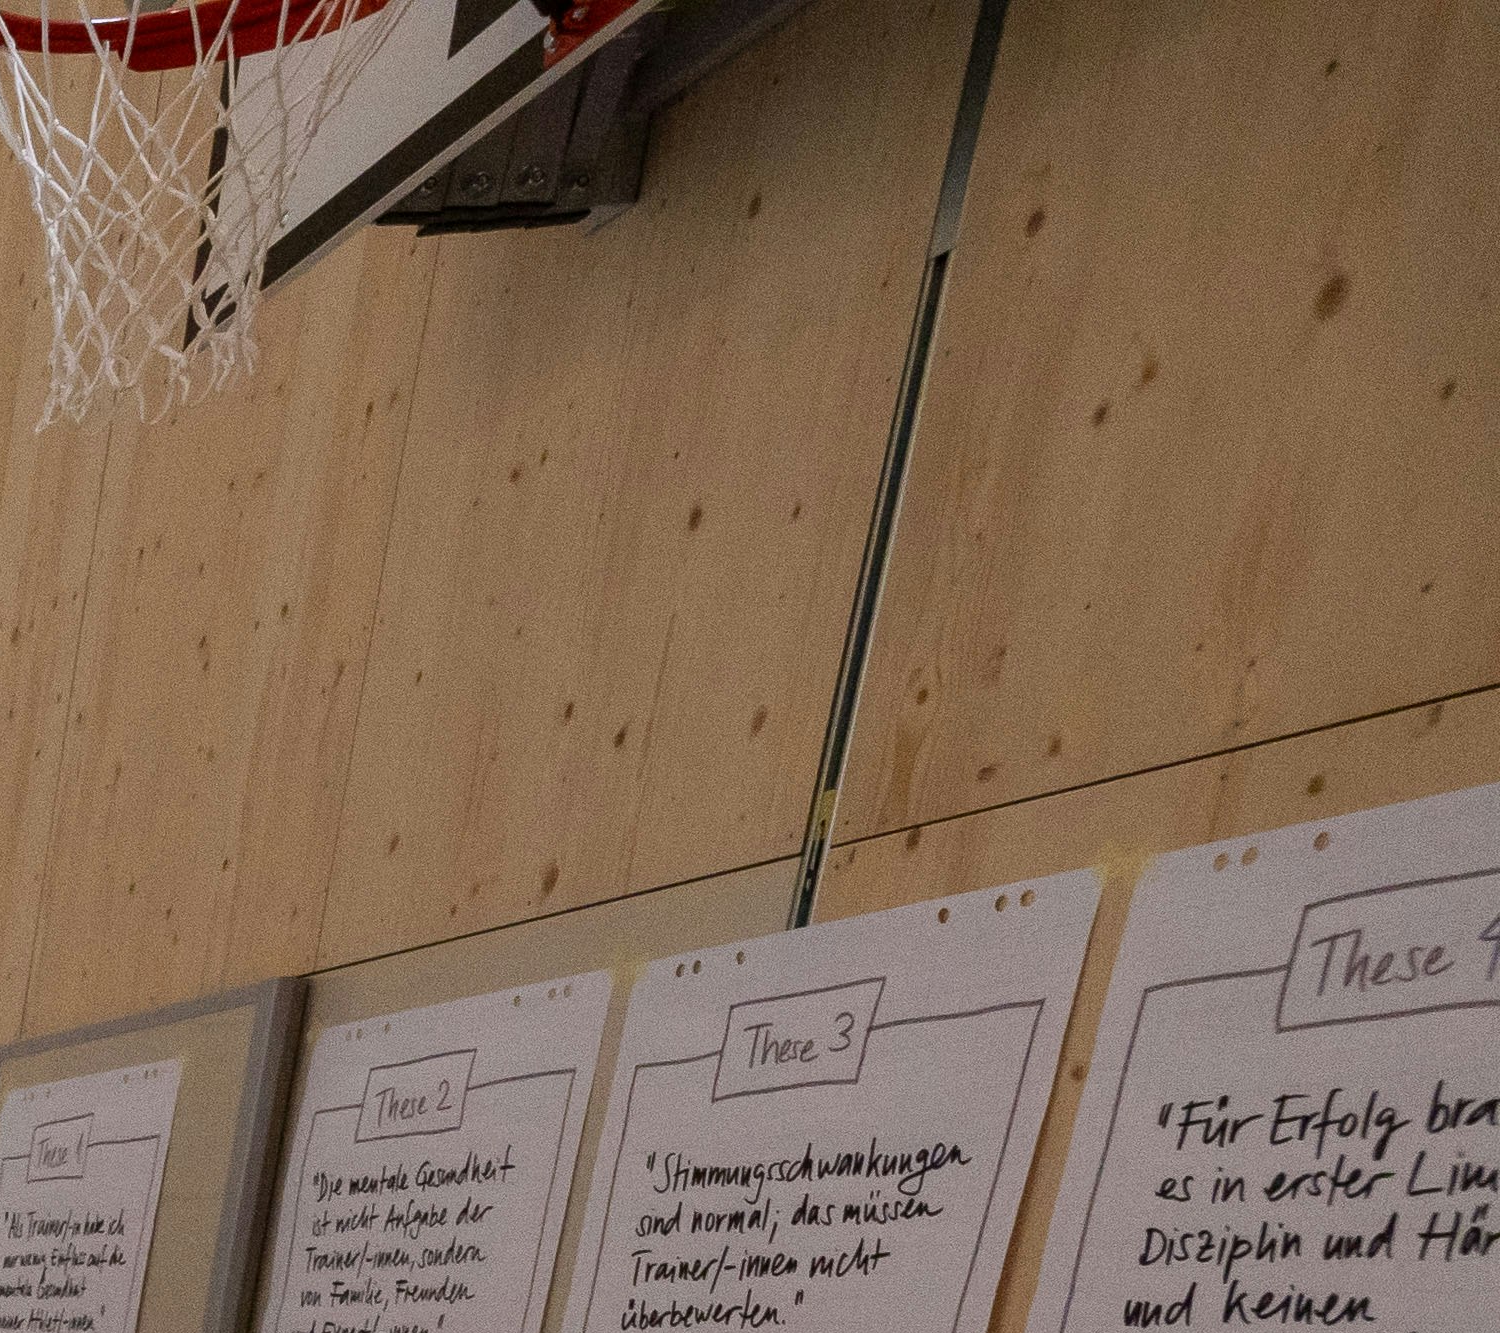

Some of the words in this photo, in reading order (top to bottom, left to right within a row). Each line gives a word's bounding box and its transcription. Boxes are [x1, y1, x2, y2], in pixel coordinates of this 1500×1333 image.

[1311, 929, 1456, 996] These
[744, 1022, 819, 1068] These
[828, 1012, 855, 1051] 3
[376, 1087, 427, 1126] These
[437, 1079, 452, 1111] 2
[1158, 1094, 1263, 1150] "Für
[1270, 1088, 1410, 1161] Erfolg
[349, 1165, 408, 1196] mentale
[415, 1144, 515, 1192] Gesundheit
[645, 1137, 972, 1204] "Stimmungsschwankungen
[1155, 1173, 1194, 1201] es
[1212, 1167, 1246, 1204] in
[1263, 1154, 1396, 1207] erster
[312, 1210, 331, 1236] ist
[335, 1203, 378, 1234] nicht
[383, 1199, 447, 1240] Aufgabe
[456, 1196, 493, 1226] der
[635, 1201, 682, 1237] sind
[691, 1198, 781, 1244] normal;
[791, 1193, 834, 1226] das
[842, 1191, 944, 1224] müssen
[418, 1236, 486, 1269] sondern
[631, 1246, 798, 1294] Trainer/-innen
[809, 1238, 891, 1279] nicht
[1139, 1222, 1301, 1285] Disziplin
[1322, 1211, 1398, 1260] und
[300, 1289, 322, 1307] von
[331, 1277, 388, 1312] Familie,
[395, 1275, 475, 1306] Freunden
[621, 1289, 804, 1330] überbewerten."
[1124, 1281, 1198, 1327] und
[1222, 1280, 1376, 1326] keinen
